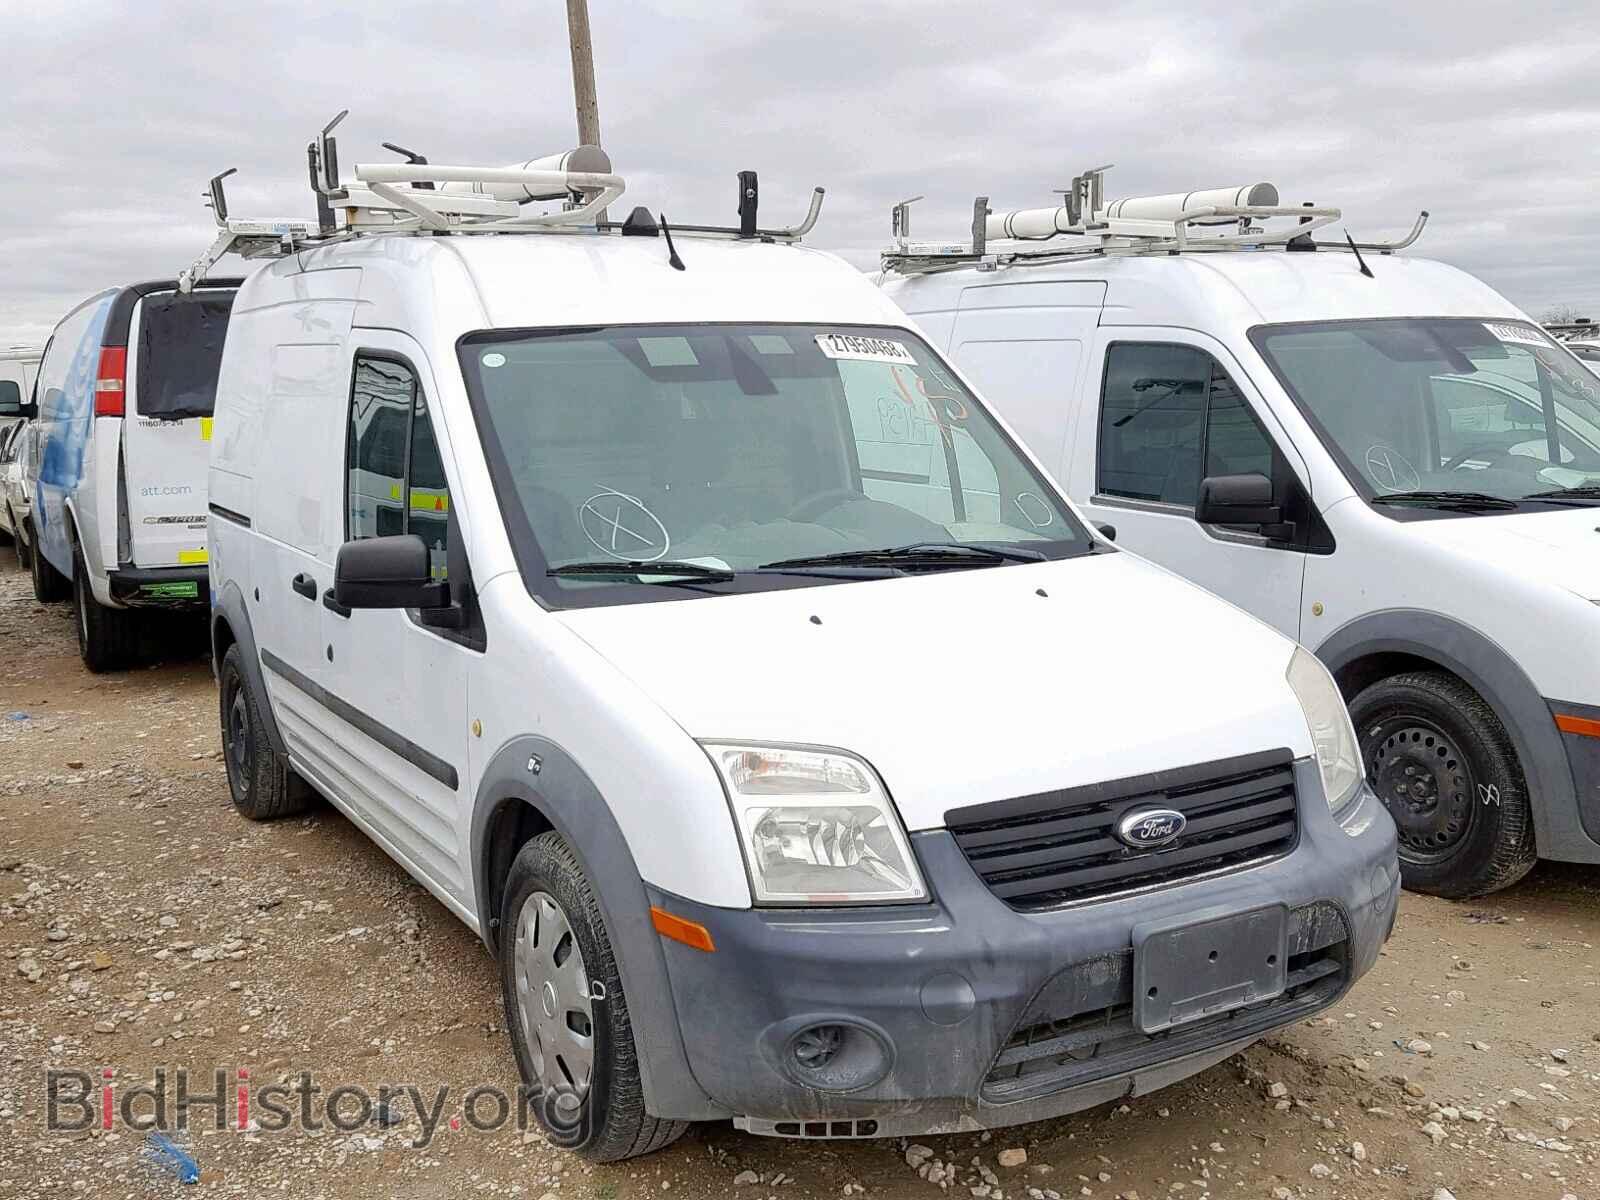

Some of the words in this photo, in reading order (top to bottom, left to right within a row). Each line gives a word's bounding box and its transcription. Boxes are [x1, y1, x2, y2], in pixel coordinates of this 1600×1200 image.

[828, 335, 901, 357] 27950468
[141, 486, 192, 496] att.com
[1140, 818, 1175, 839] Ford
